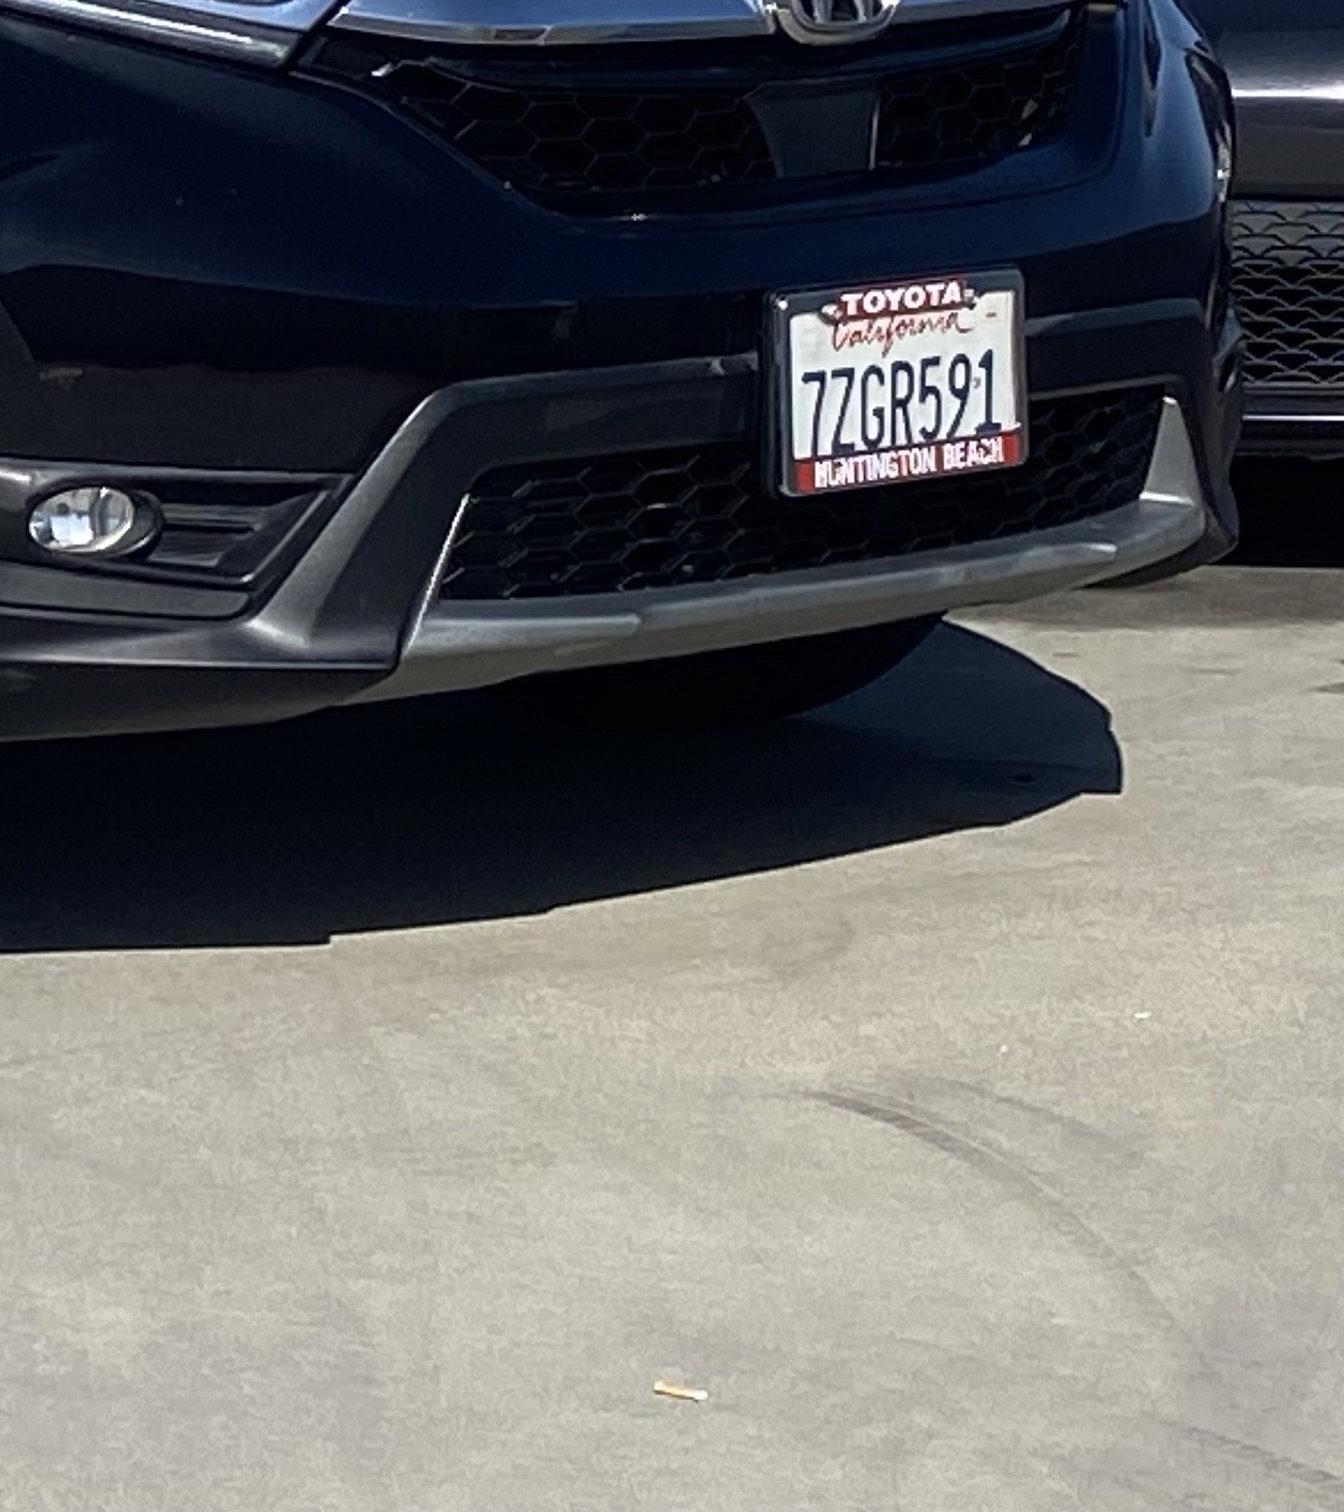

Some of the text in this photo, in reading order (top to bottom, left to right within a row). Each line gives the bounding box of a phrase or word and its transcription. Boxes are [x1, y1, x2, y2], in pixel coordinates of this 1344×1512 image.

[840, 280, 962, 316] TOYOTA
[831, 310, 975, 358] California
[800, 348, 1002, 460] 7ZGR591
